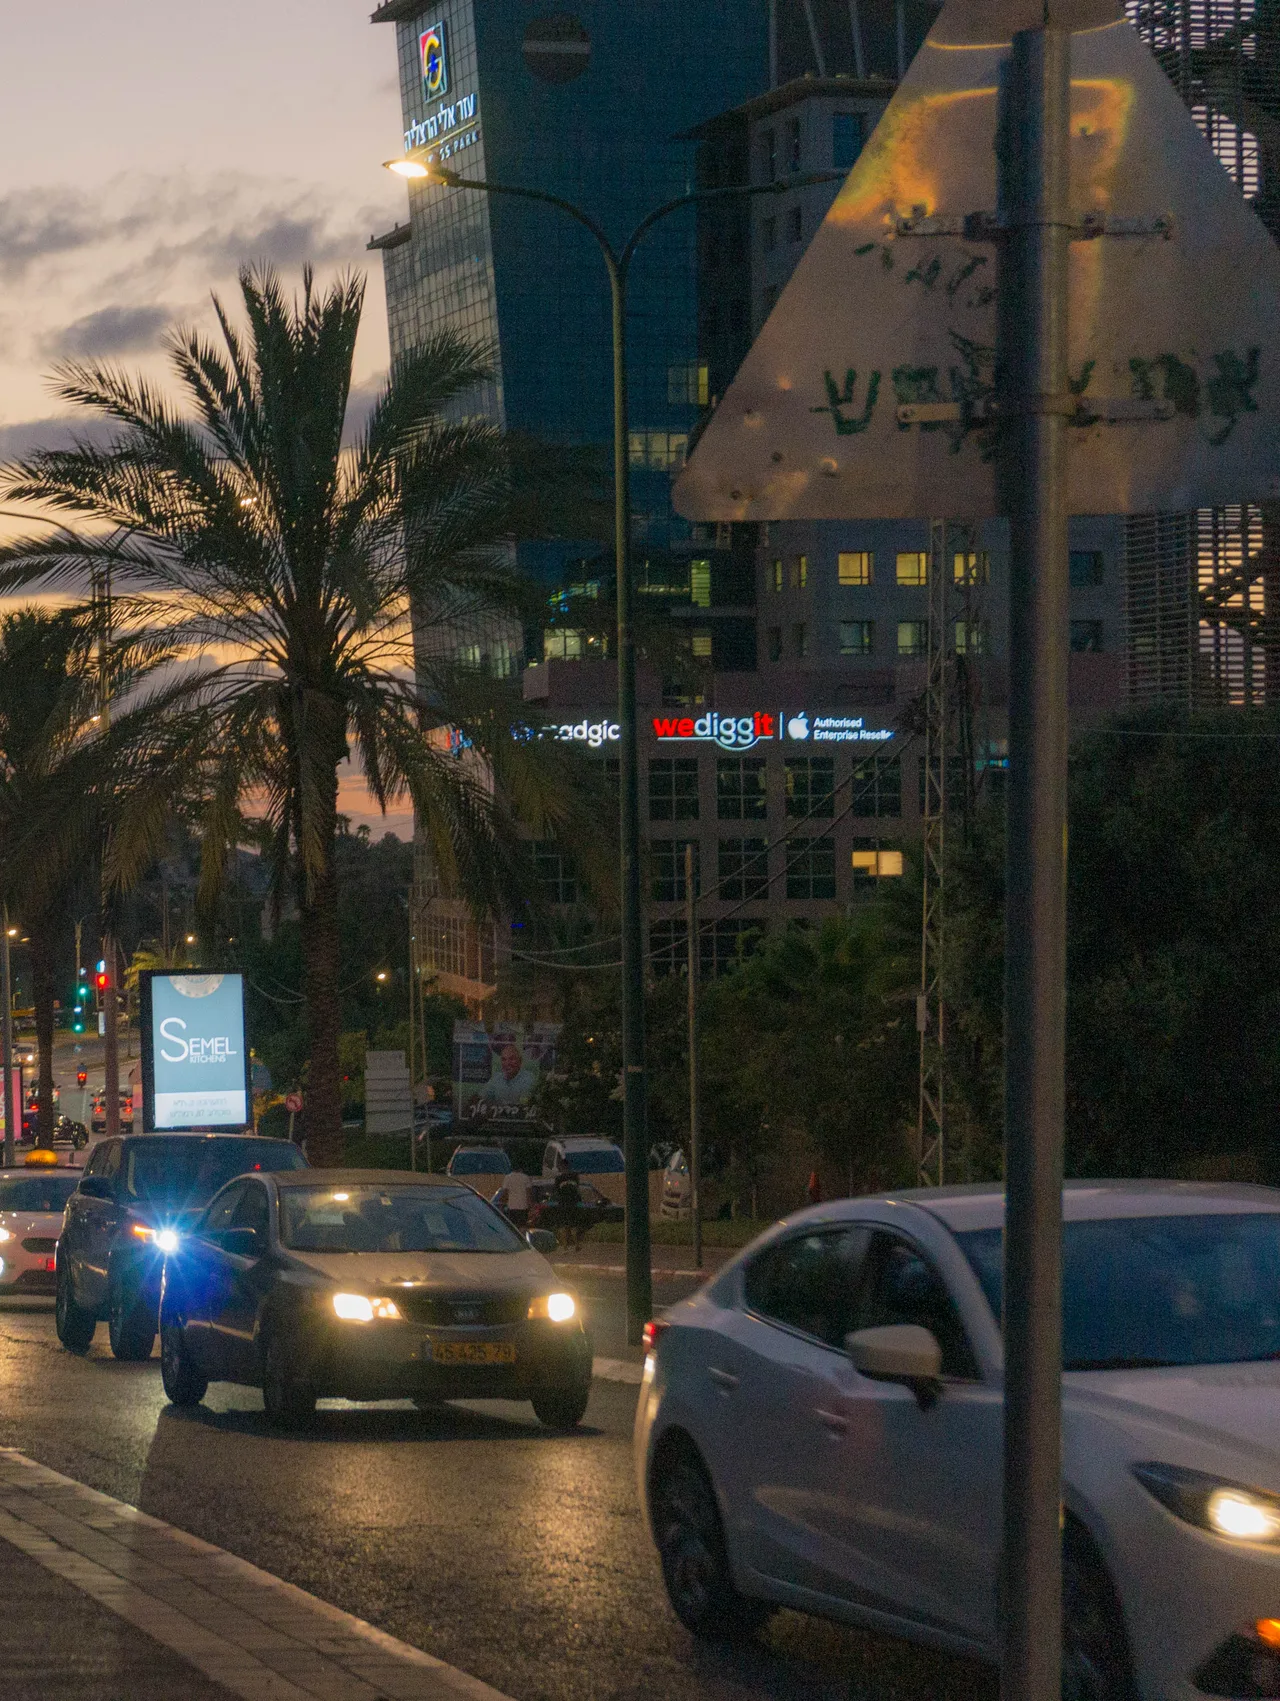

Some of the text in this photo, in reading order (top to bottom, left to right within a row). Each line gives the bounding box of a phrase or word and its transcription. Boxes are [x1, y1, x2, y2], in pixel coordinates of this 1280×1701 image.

[653, 711, 773, 744] wediggit
[813, 717, 863, 728] Authorised
[813, 730, 859, 742] Enterprise
[160, 1017, 237, 1062] SEMEL
